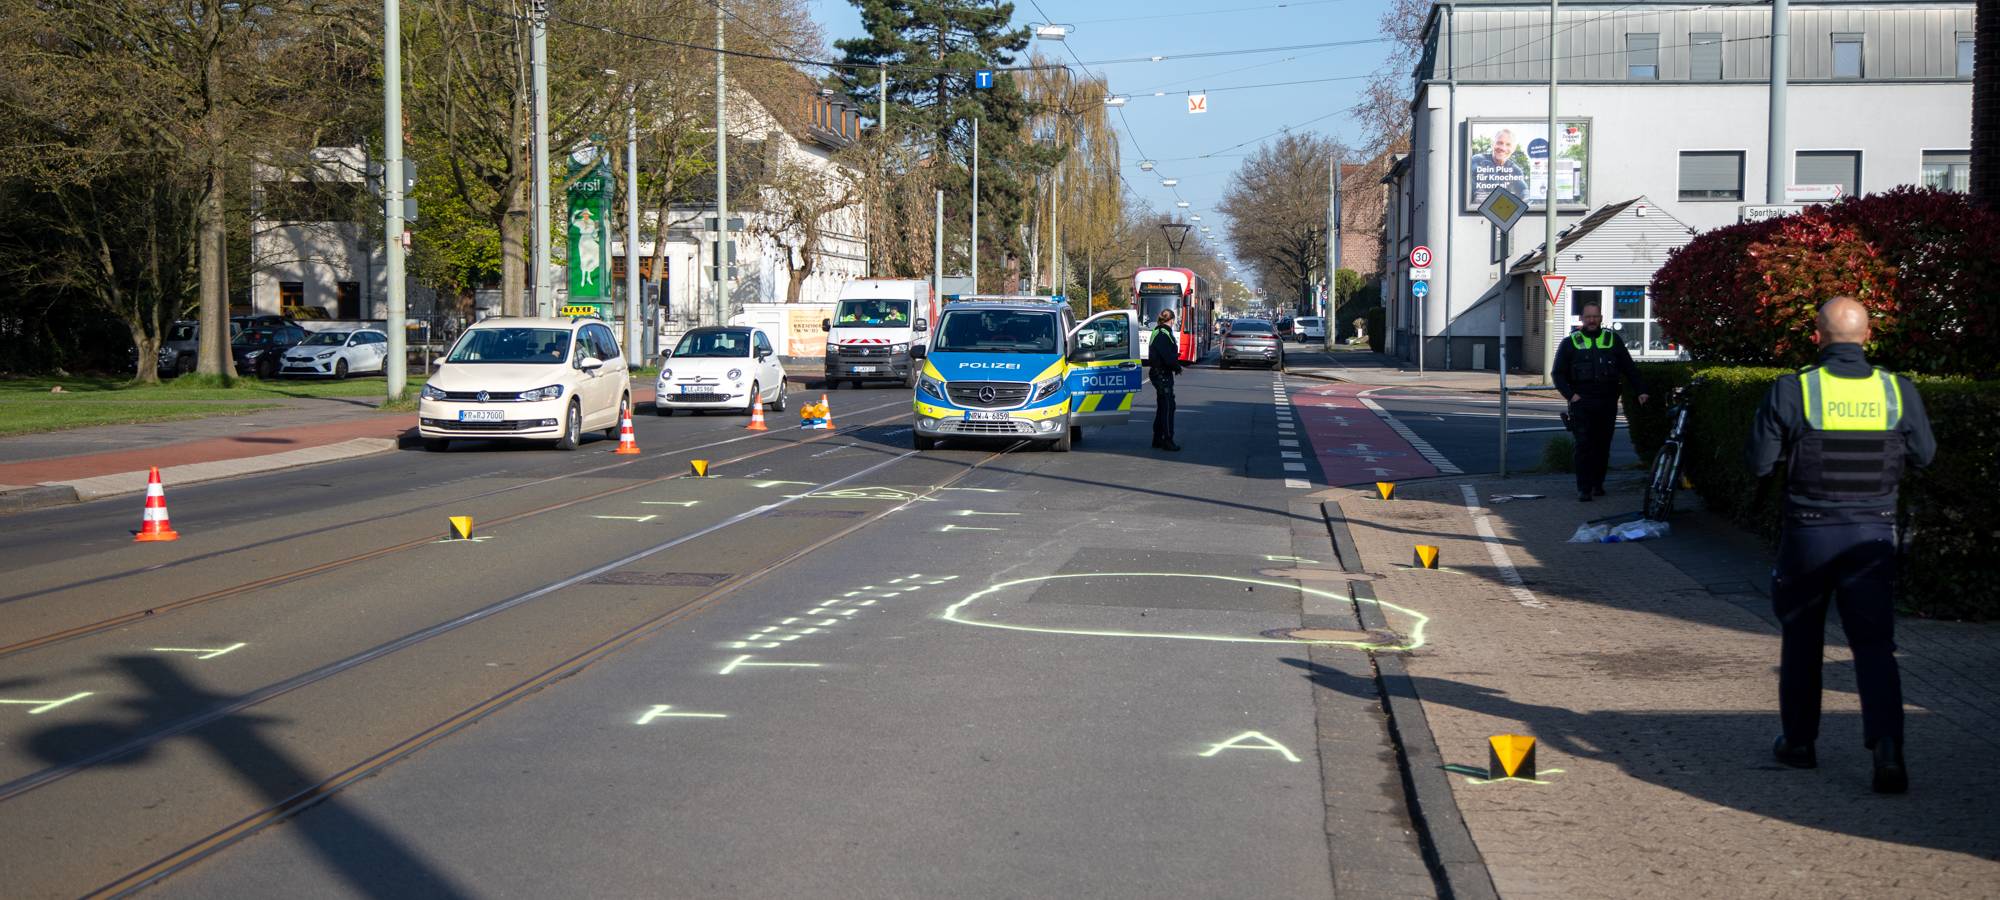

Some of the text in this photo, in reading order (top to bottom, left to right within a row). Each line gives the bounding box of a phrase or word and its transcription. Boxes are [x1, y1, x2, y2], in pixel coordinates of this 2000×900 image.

[979, 72, 989, 87] T
[1749, 208, 1786, 217] Sporthalle
[1415, 252, 1427, 262] 30
[959, 362, 1021, 370] POLIZEI
[1082, 375, 1127, 387] POLIZEI
[1827, 401, 1881, 418] POLIZEI
